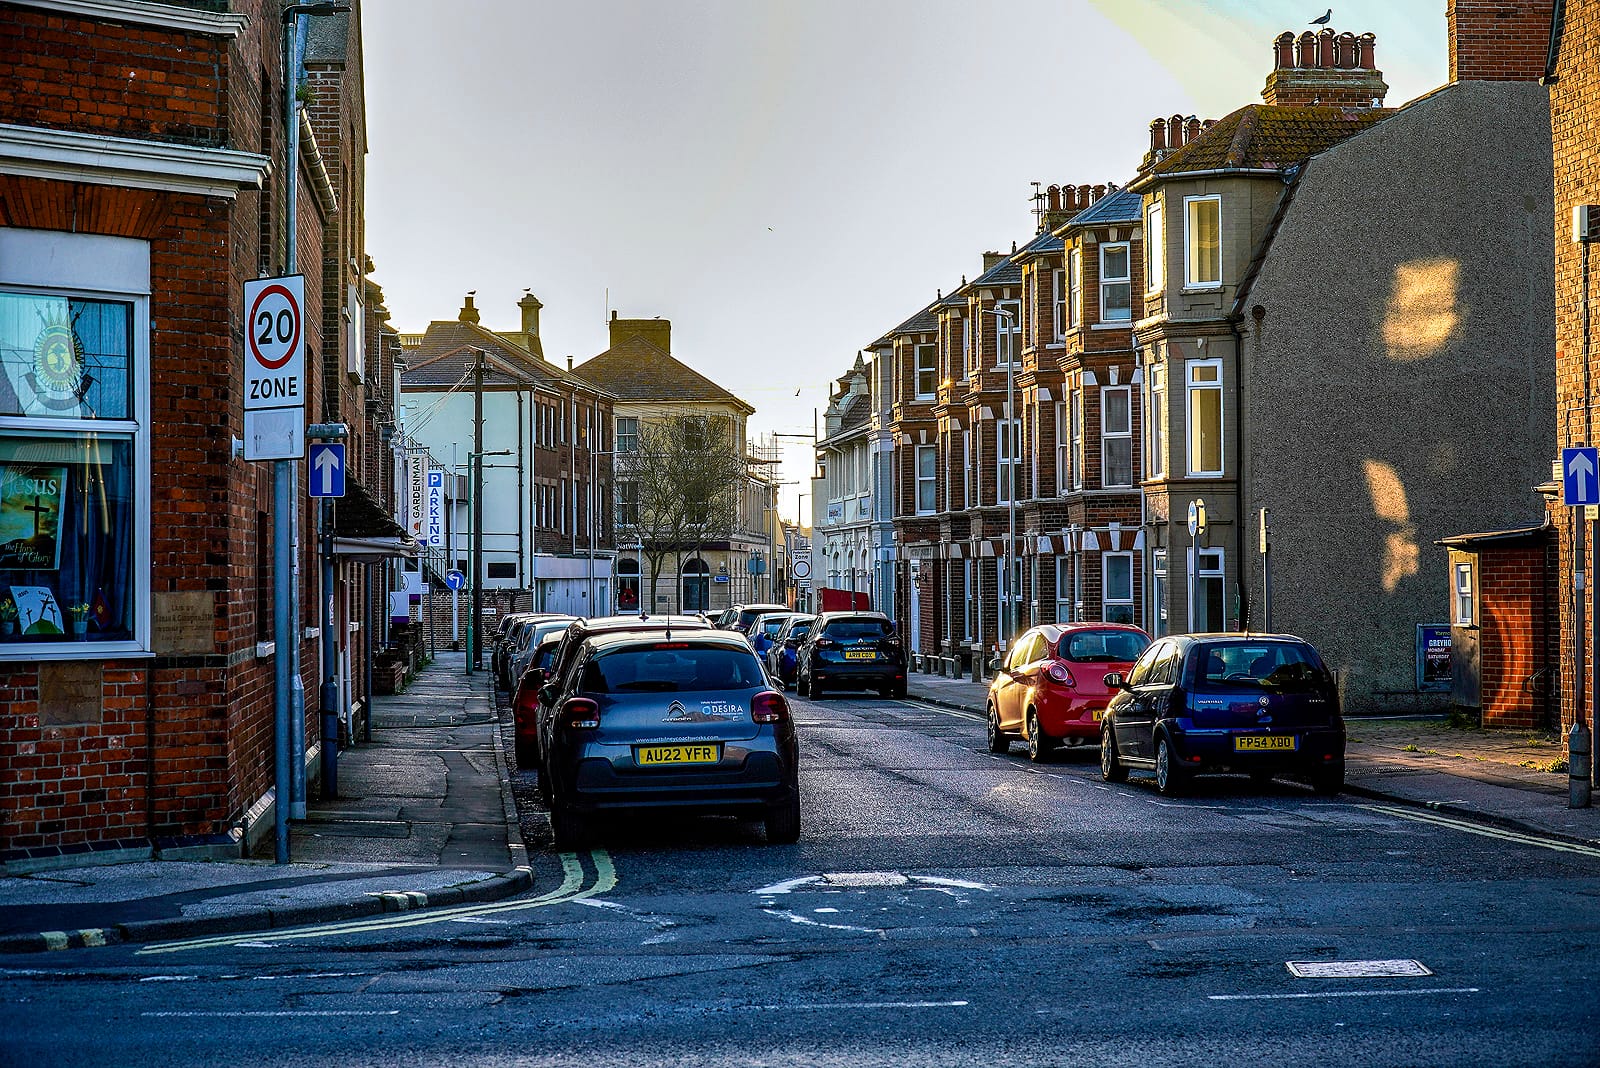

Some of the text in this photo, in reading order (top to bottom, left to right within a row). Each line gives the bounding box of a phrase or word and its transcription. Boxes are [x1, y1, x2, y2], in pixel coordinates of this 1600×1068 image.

[257, 308, 294, 346] 20
[250, 376, 298, 400] ZONE
[8, 477, 57, 498] Jesus
[412, 457, 421, 519] GARDENMAN
[430, 475, 439, 544] PARKING
[712, 704, 744, 713] DESIRA
[1239, 737, 1268, 748] FP54
[646, 747, 712, 762] AU22 YFR
